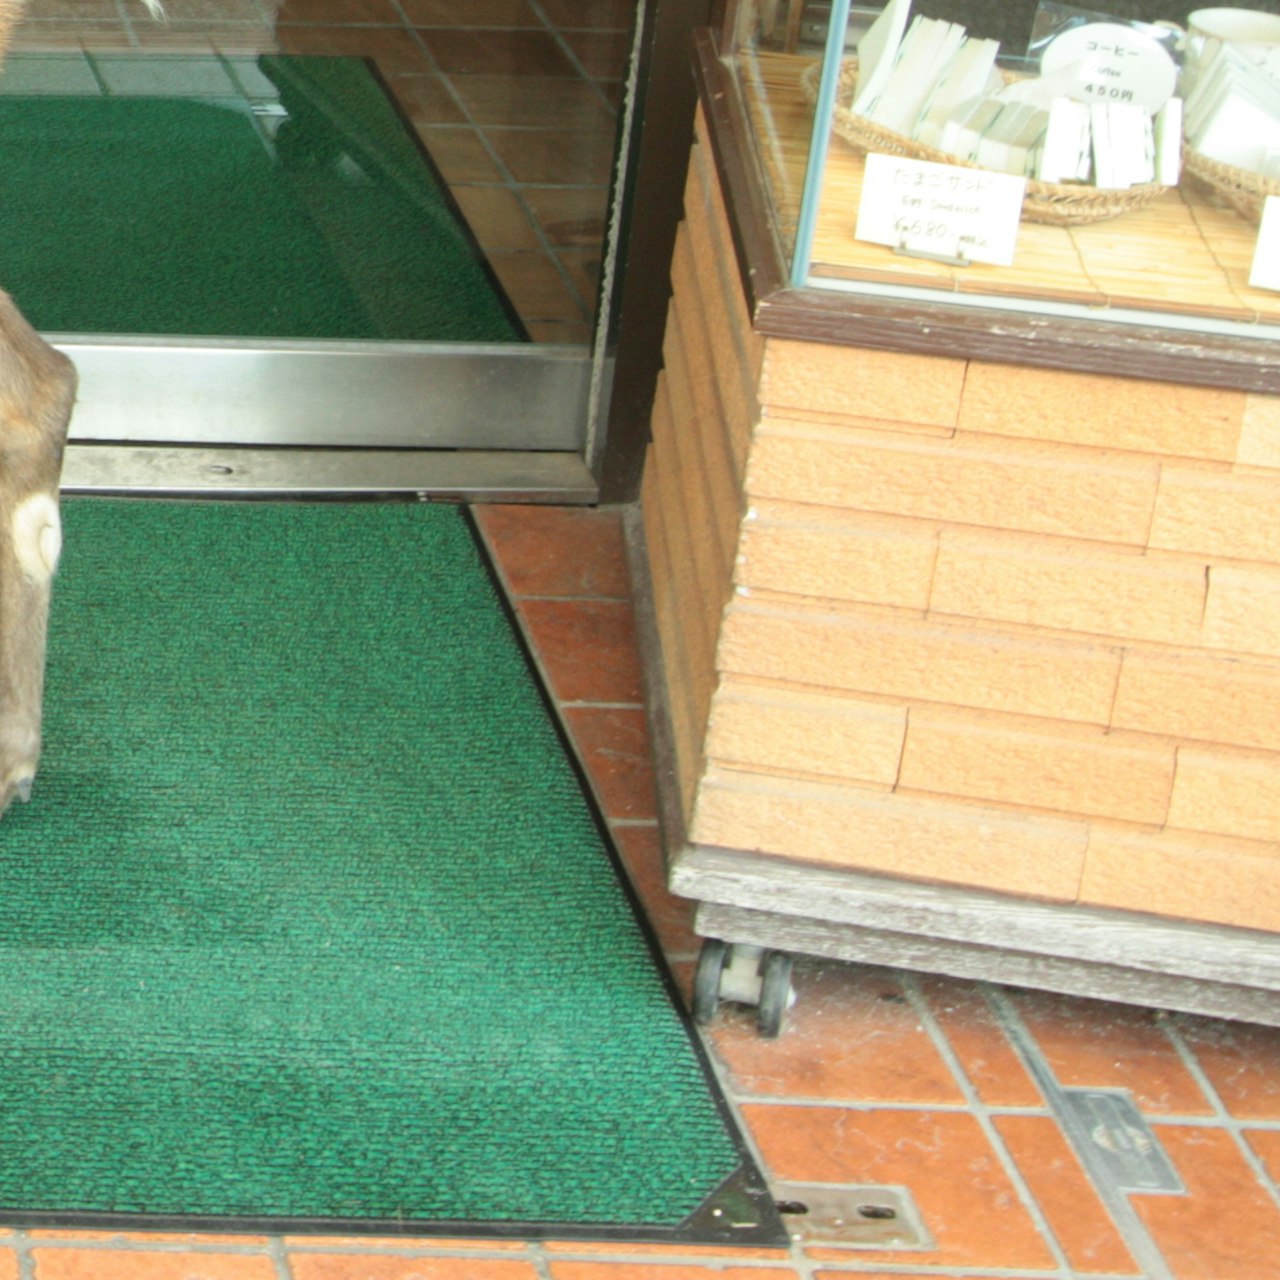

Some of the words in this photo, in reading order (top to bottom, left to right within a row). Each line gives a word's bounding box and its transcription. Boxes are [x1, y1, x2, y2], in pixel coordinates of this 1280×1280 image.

[1086, 40, 1139, 58] コーヒー
[1083, 82, 1134, 102] 450円
